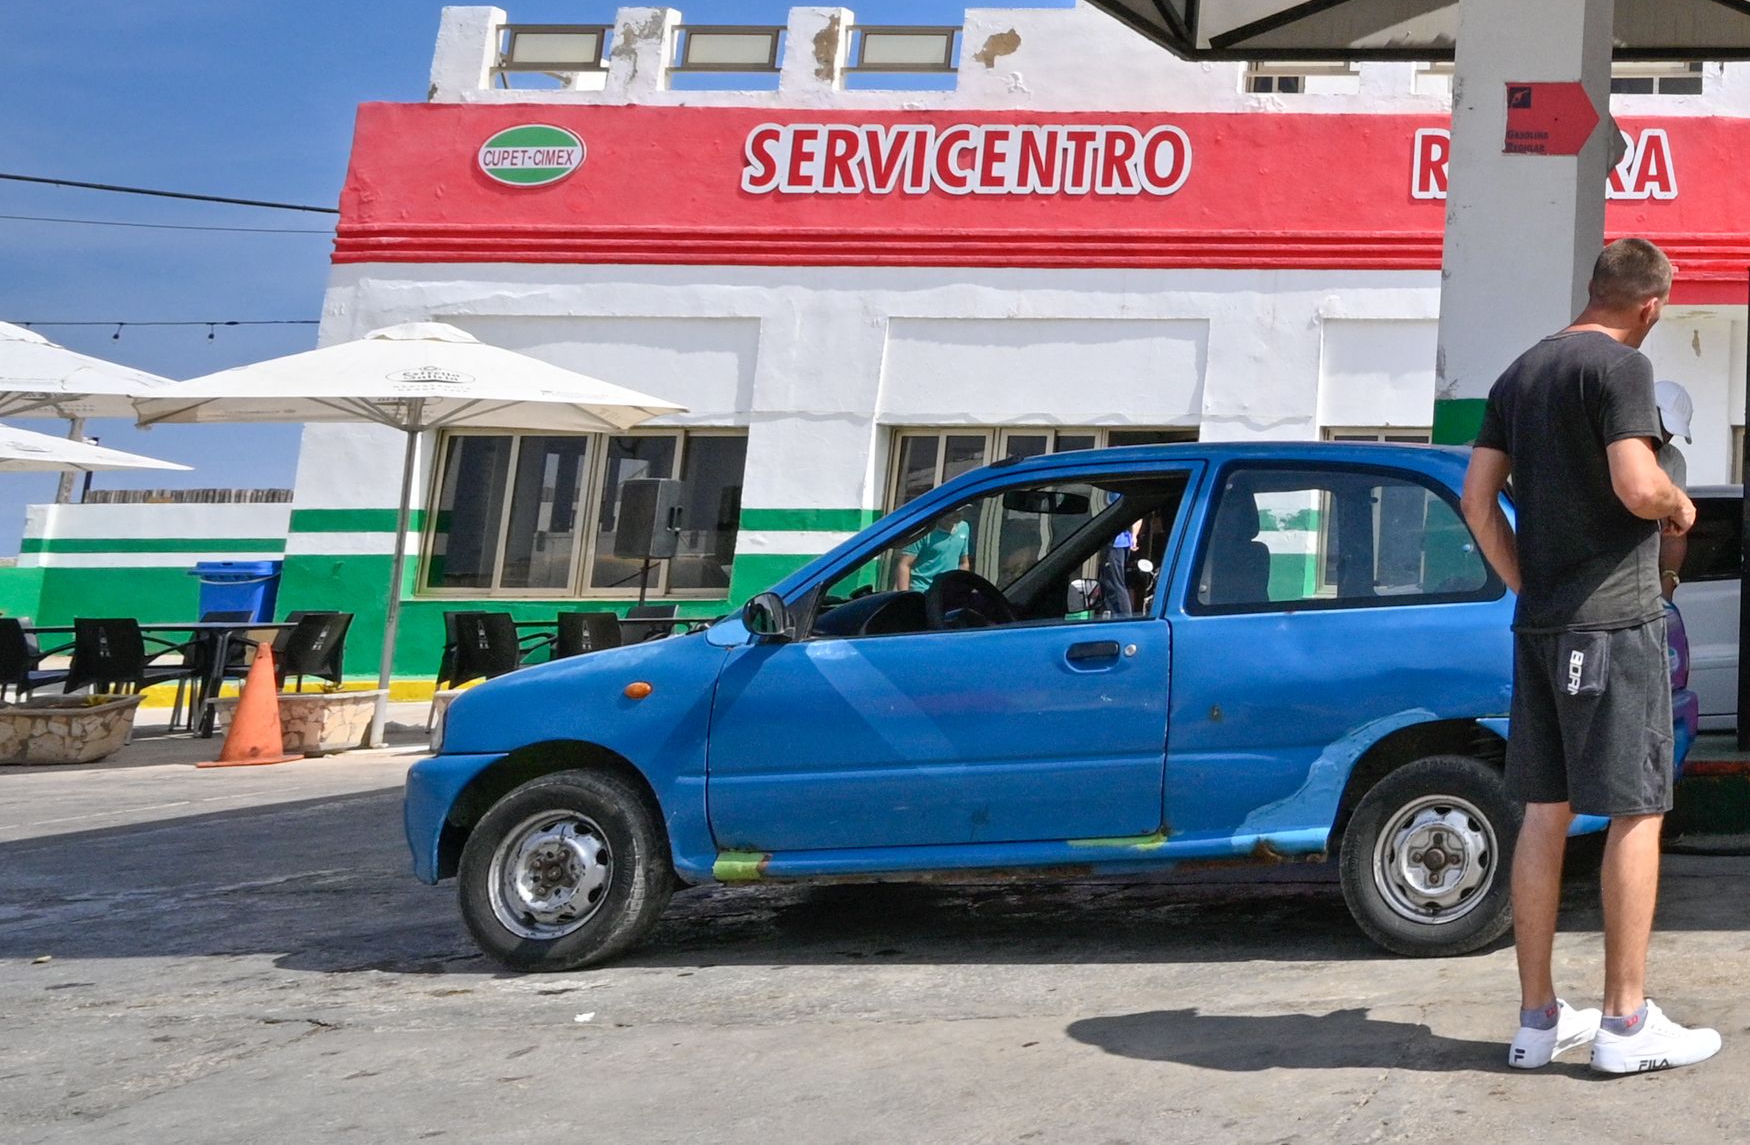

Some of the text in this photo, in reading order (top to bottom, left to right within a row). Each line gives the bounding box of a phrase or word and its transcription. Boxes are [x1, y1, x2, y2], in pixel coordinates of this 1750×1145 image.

[482, 149, 575, 167] CUPET-CIMEX
[747, 128, 1186, 190] SERVICENTRO
[1638, 1058, 1670, 1072] FILA
